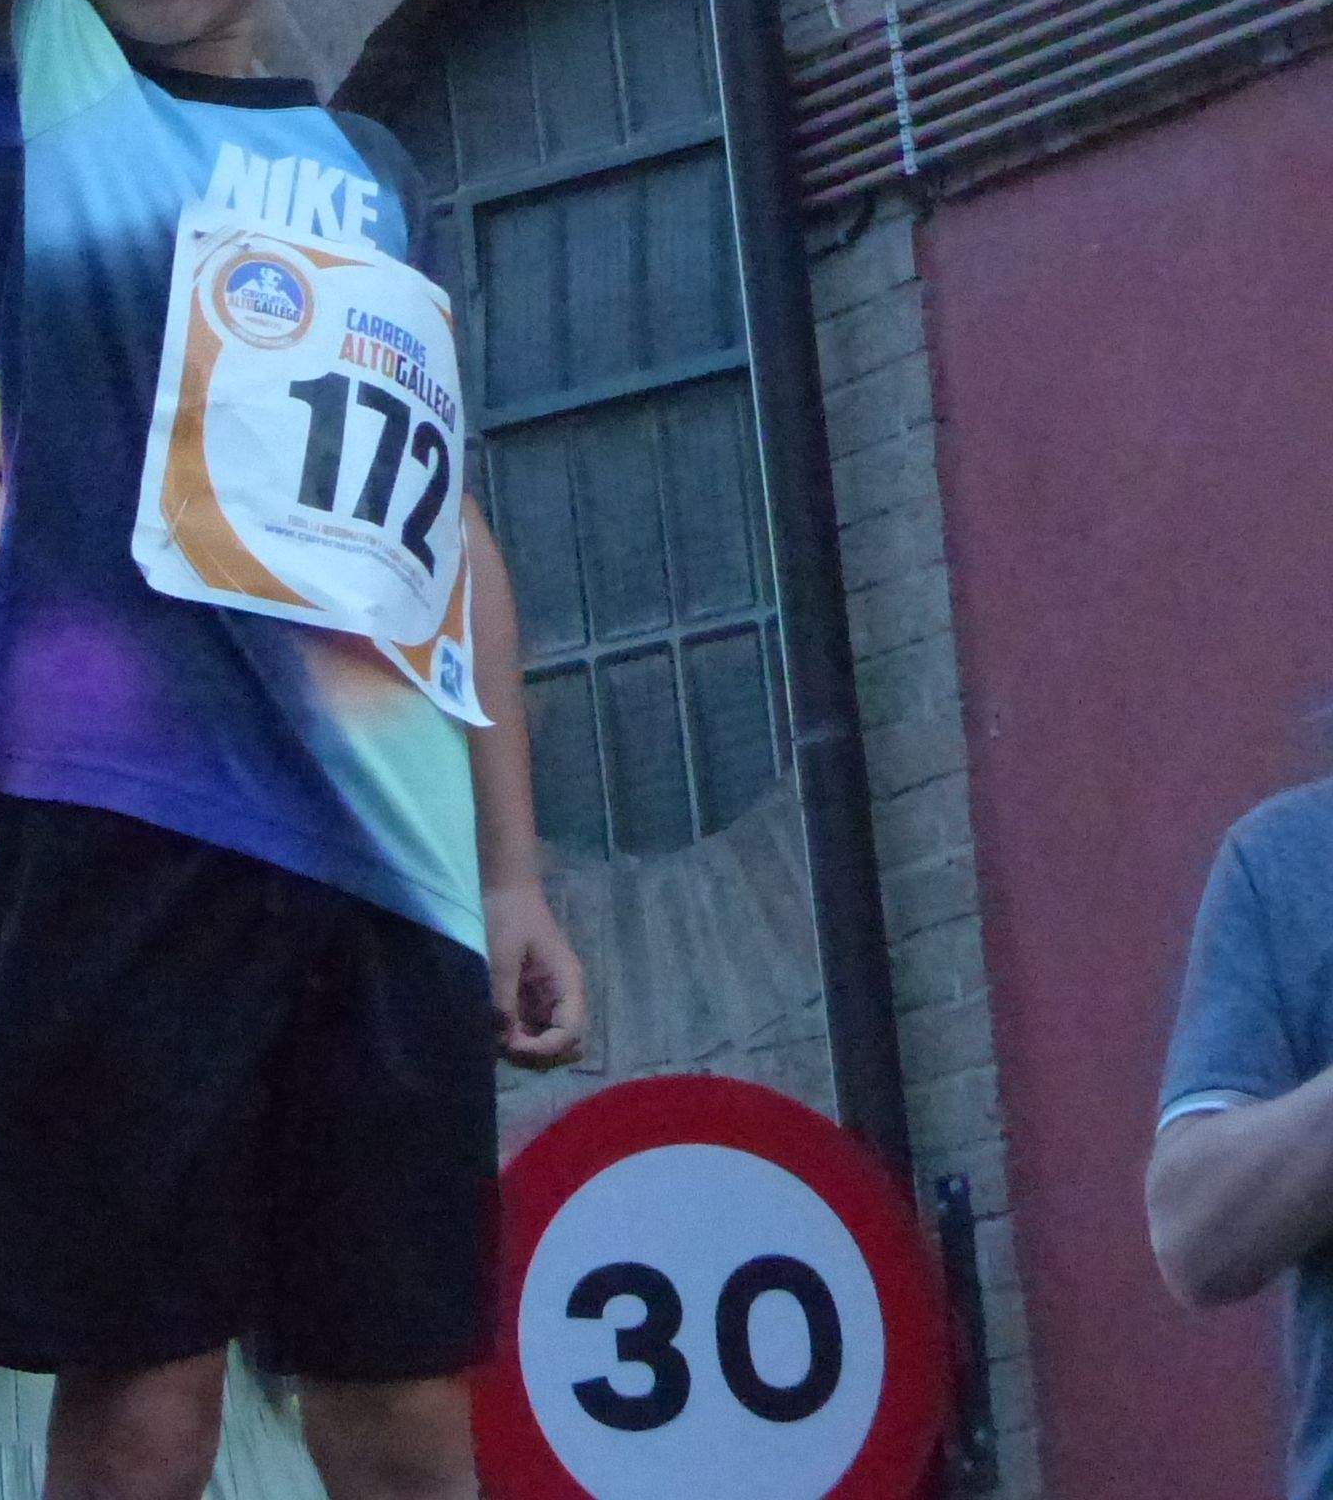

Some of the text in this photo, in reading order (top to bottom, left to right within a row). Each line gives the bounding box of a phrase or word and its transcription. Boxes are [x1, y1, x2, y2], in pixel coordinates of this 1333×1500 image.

[203, 141, 379, 250] NIKE
[338, 332, 456, 434] ALTOGALLEGO
[345, 306, 427, 368] CARRERAS
[288, 370, 451, 579] 172
[565, 1253, 844, 1432] 30
